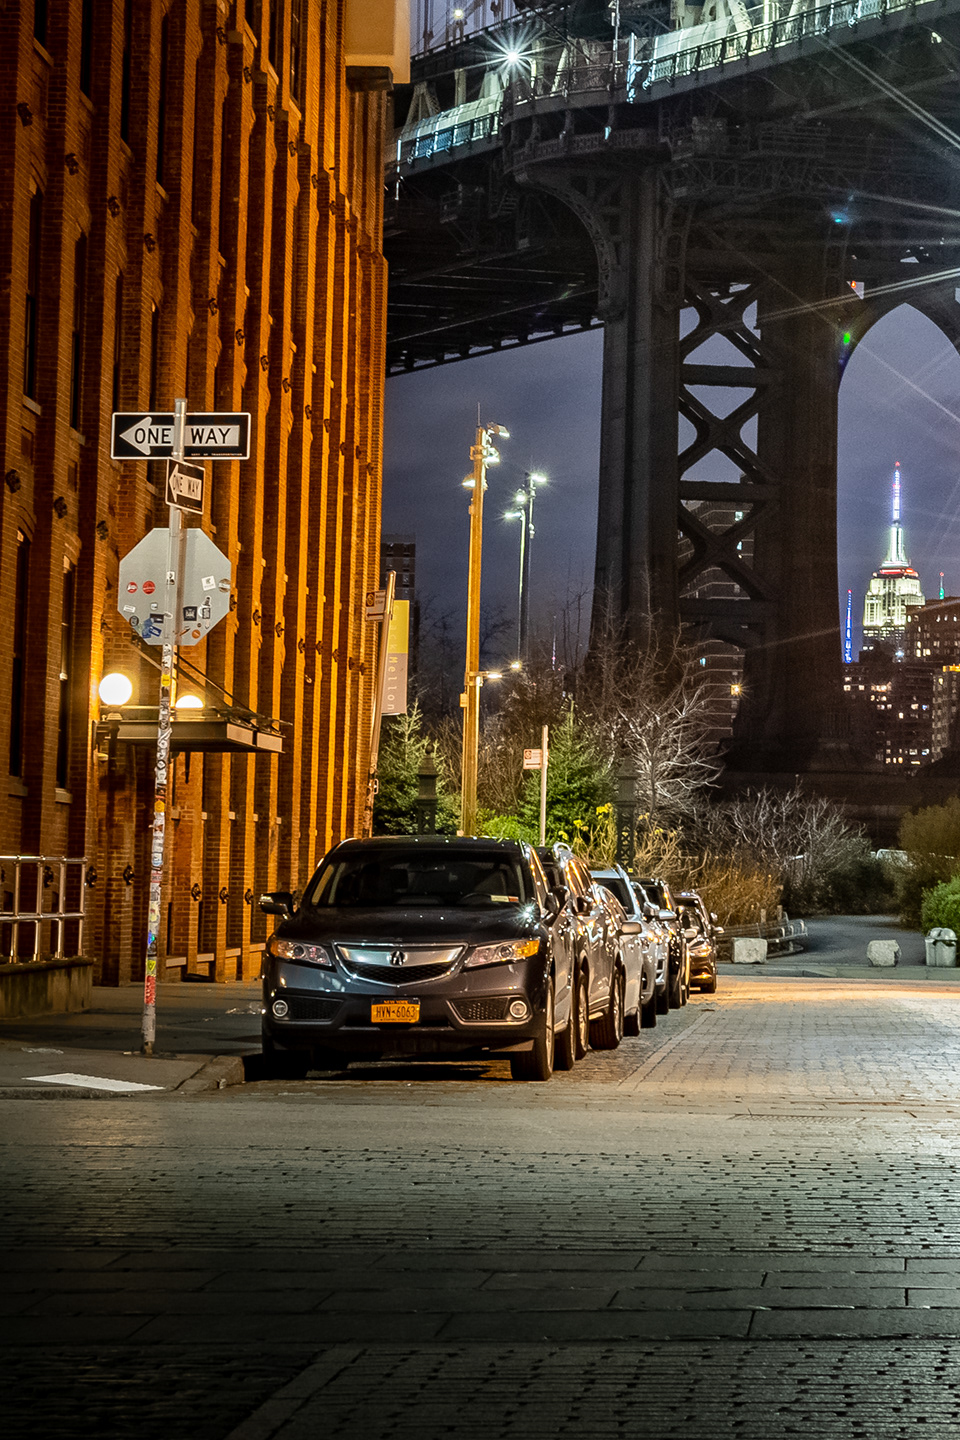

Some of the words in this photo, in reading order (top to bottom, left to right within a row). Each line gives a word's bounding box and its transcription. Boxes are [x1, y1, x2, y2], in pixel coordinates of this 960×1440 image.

[134, 427, 172, 445] ONE
[190, 428, 231, 445] WAY
[172, 474, 183, 493] ONE
[187, 478, 200, 499] WAY
